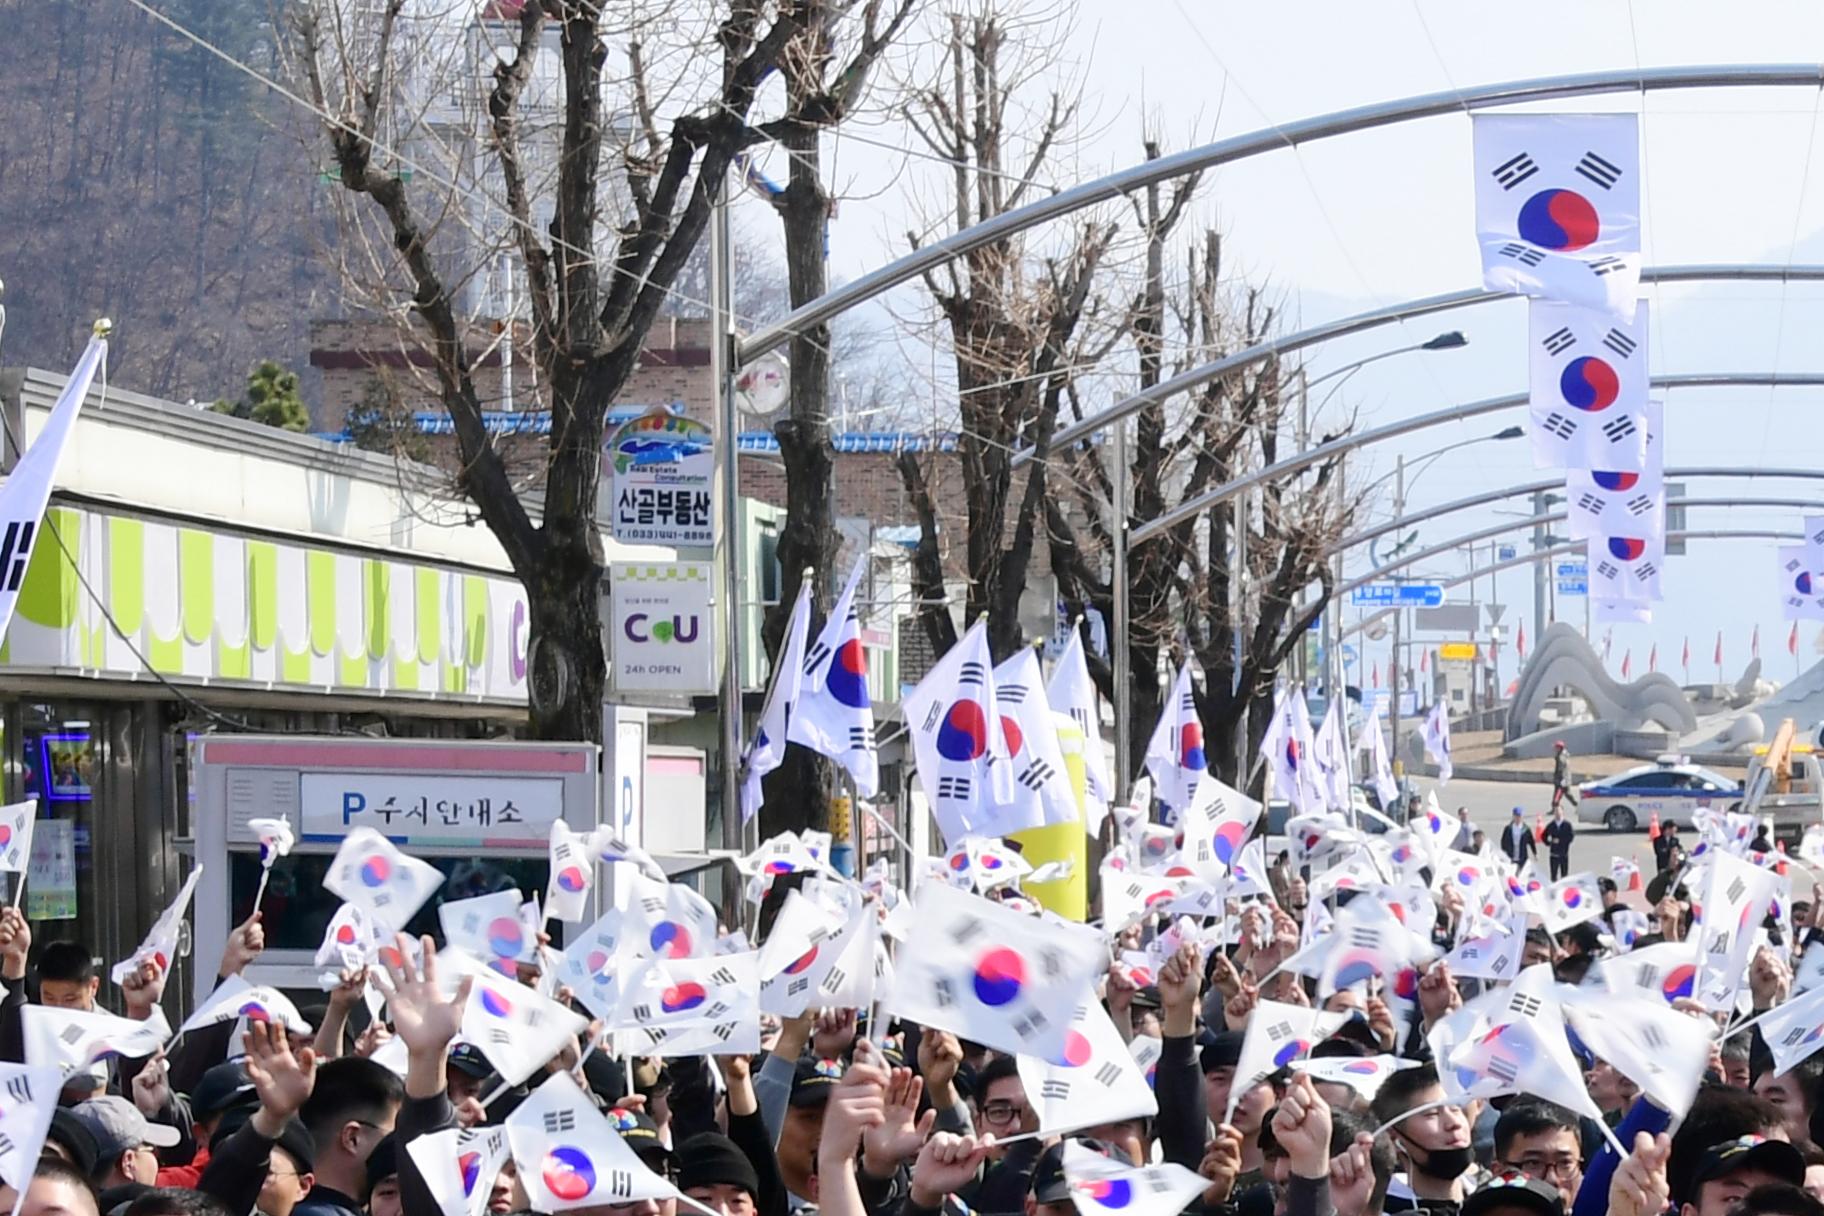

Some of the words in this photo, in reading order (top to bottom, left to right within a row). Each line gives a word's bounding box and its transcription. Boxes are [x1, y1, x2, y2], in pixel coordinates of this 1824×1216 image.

[618, 487, 711, 526] 산골부동산
[624, 612, 699, 644] CU
[625, 665, 646, 675] 24h
[648, 665, 682, 675] OPEN
[342, 791, 367, 826] P
